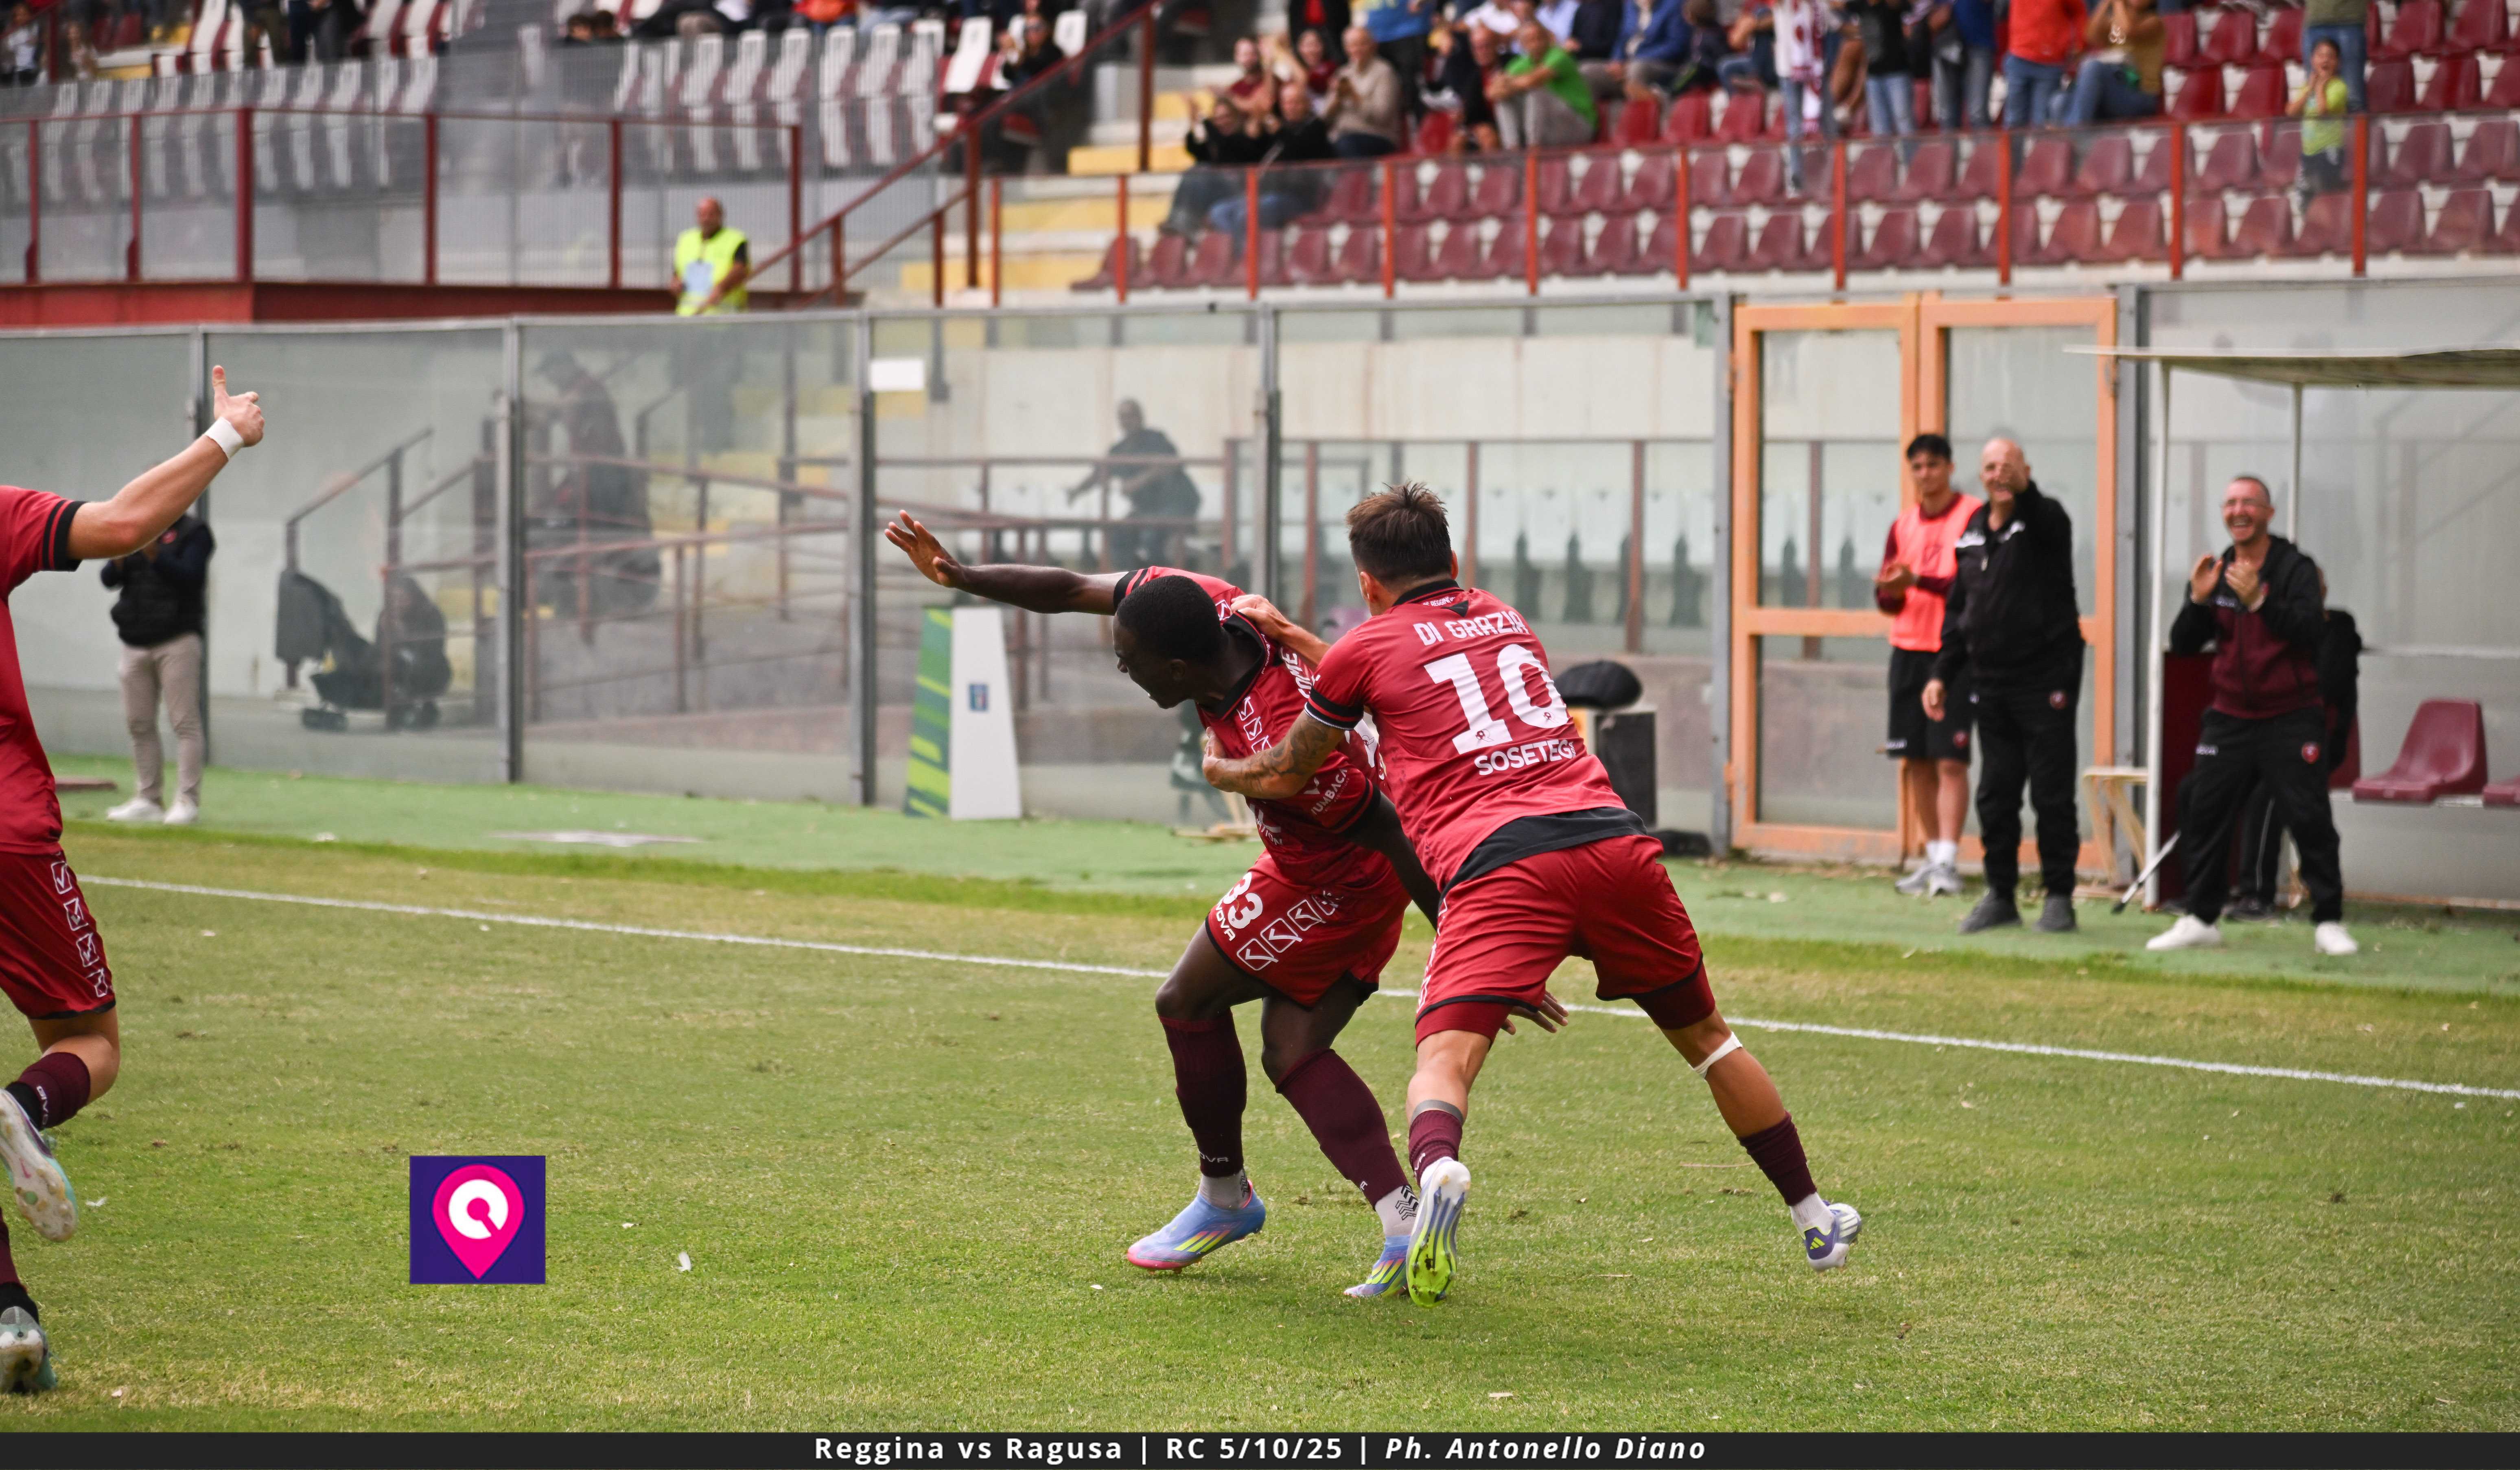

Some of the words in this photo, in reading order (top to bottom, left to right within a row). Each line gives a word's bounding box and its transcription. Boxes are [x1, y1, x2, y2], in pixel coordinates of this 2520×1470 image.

[1413, 622, 1444, 646] DI
[1444, 610, 1531, 639] GRAZIA
[1424, 643, 1569, 755] 10
[1223, 871, 1263, 930] 33
